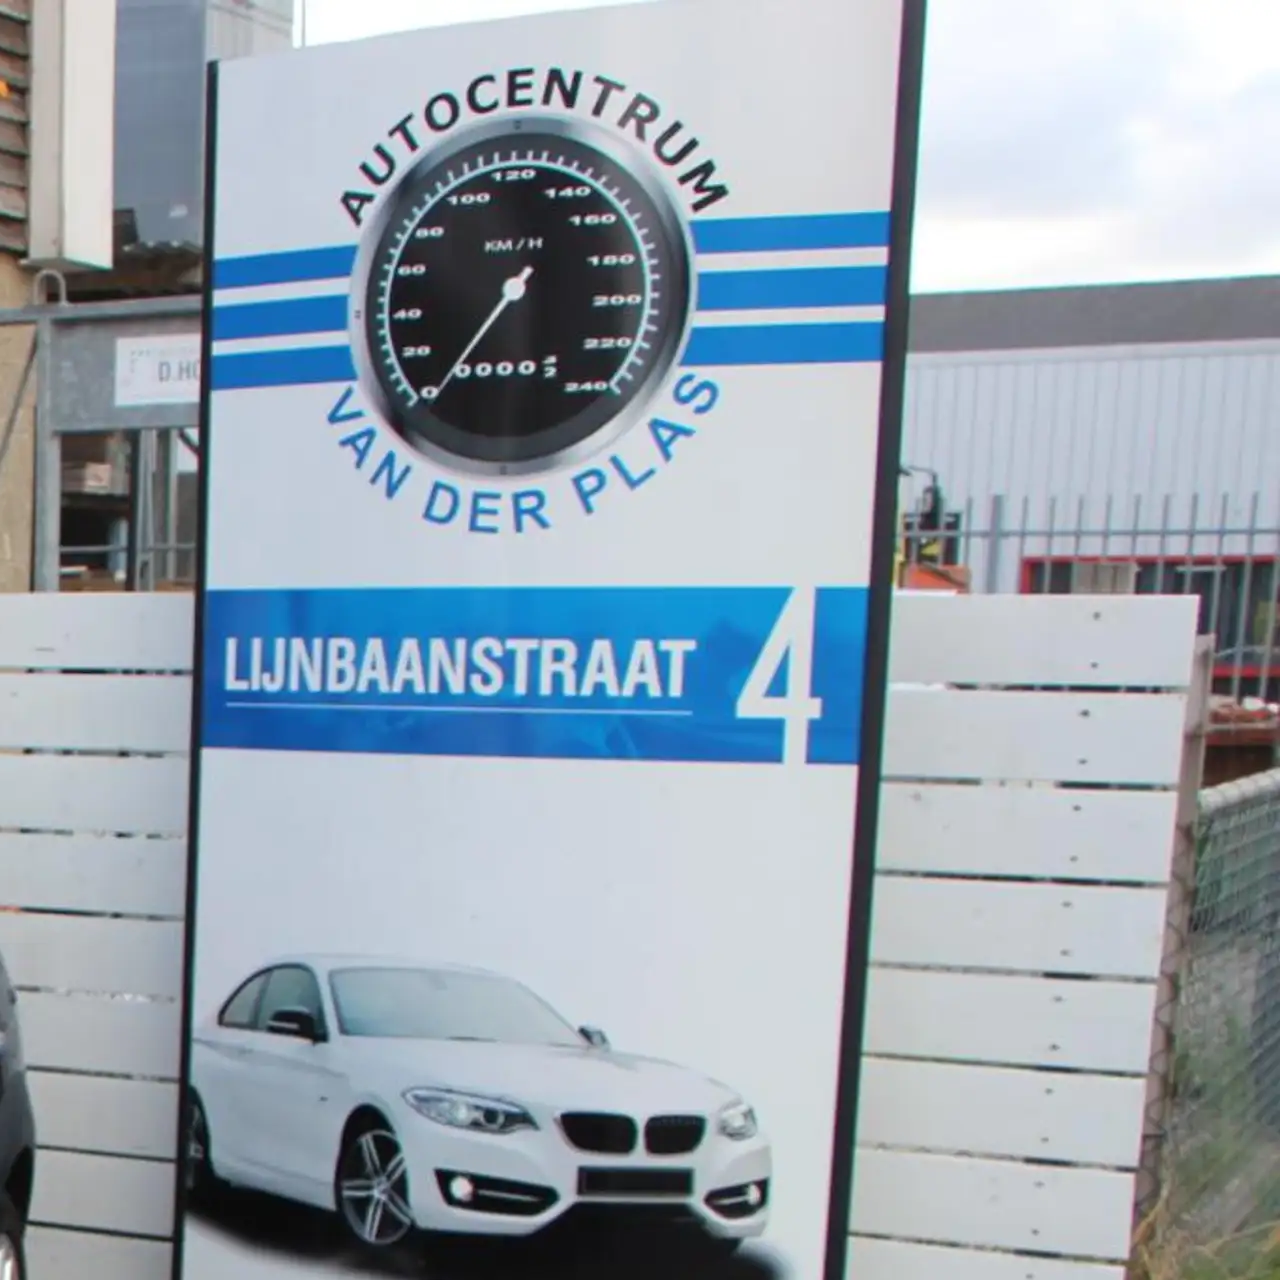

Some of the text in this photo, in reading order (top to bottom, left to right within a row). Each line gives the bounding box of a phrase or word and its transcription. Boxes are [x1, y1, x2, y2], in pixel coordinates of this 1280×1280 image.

[338, 67, 730, 229] AUTOCENTRUM
[491, 168, 536, 181] 120
[446, 192, 491, 205] 100
[544, 186, 591, 199] 140
[568, 213, 617, 226] 160
[415, 226, 445, 238] 80
[586, 253, 636, 266] 180
[398, 264, 426, 275] 60
[592, 294, 642, 307] 200
[393, 308, 422, 320] 40
[583, 337, 633, 349] 220
[402, 345, 431, 357] 20
[420, 386, 440, 399] 0
[564, 381, 608, 392] 240
[327, 372, 720, 534] VAN DER PLAS
[224, 585, 821, 764] LIJNBAANSTRAAT 4
